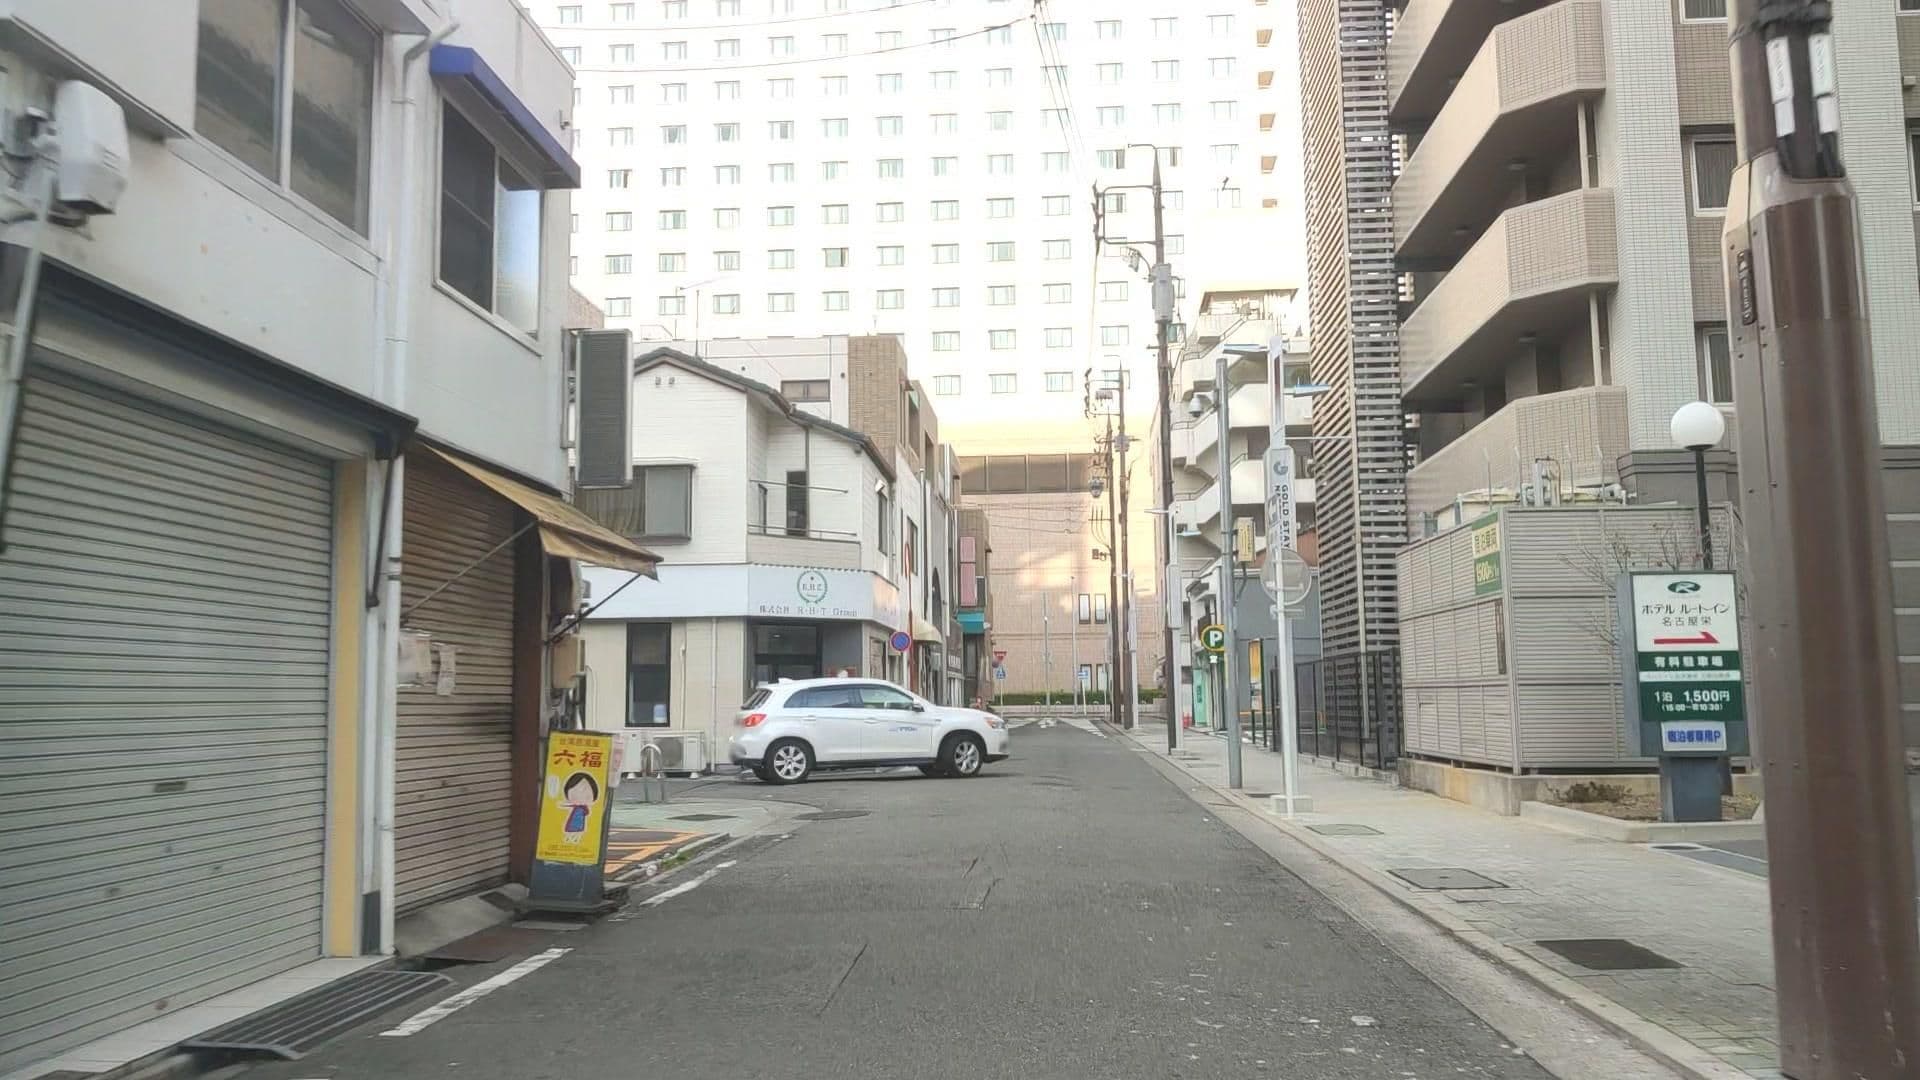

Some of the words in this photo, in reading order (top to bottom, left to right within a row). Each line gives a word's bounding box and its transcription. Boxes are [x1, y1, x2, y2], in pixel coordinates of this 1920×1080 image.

[1282, 485, 1290, 516] GOLD
[1282, 521, 1290, 548] STAY
[1642, 604, 1675, 615] ホテル
[1680, 604, 1729, 615] ルートイン
[1662, 616, 1711, 627] 名古屋栄
[1209, 630, 1223, 646] P
[1654, 655, 1723, 668] 有料駐車場
[1655, 690, 1673, 702] 1泊
[1683, 690, 1730, 703] 1,500円
[553, 749, 603, 768] 六福
